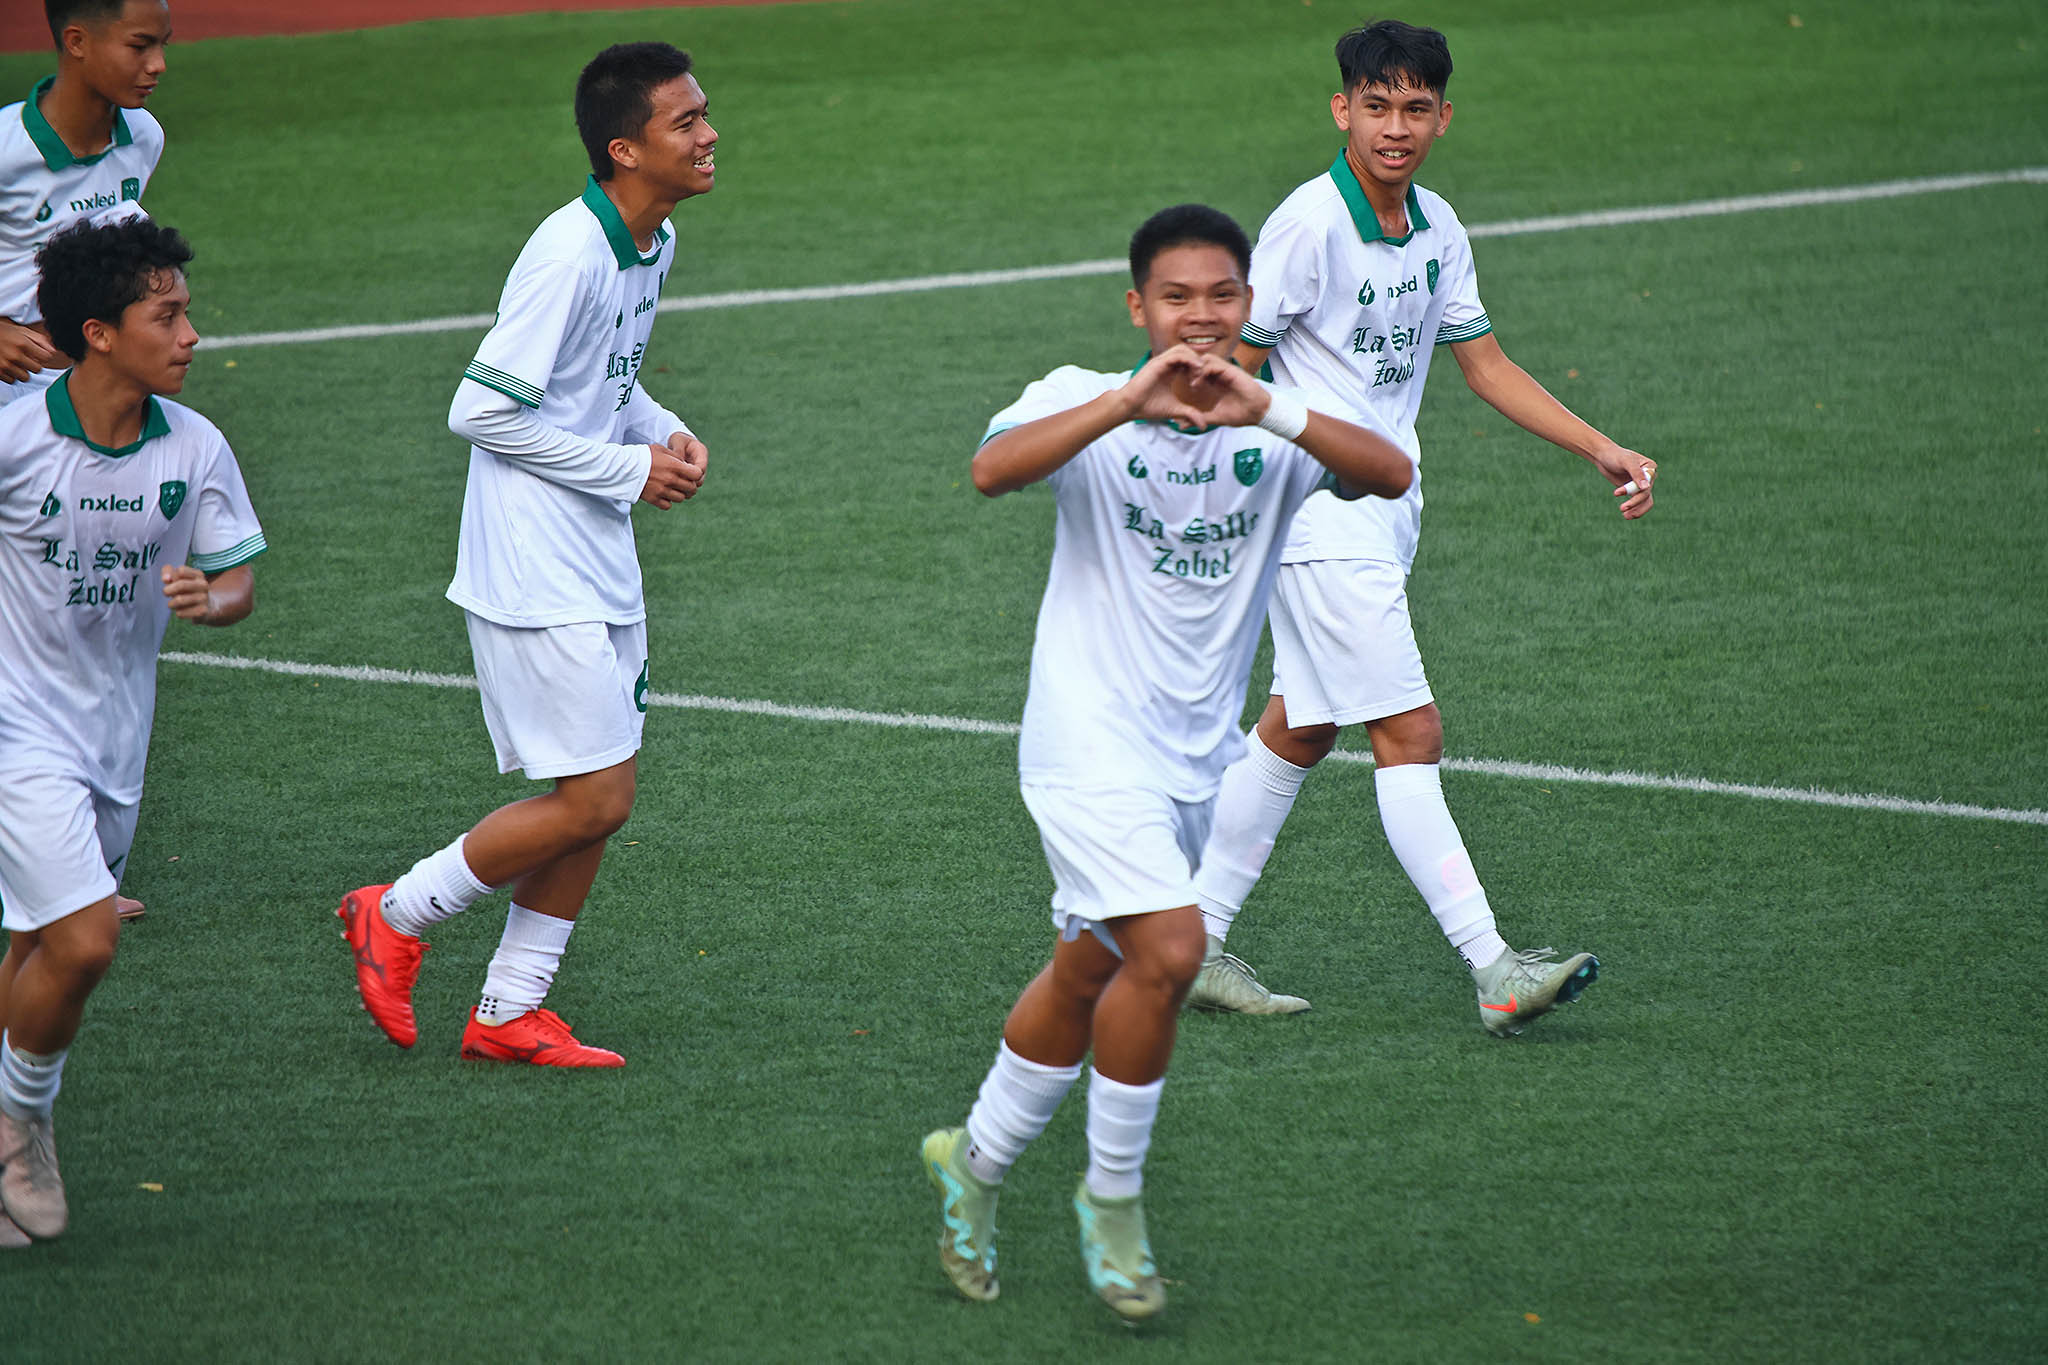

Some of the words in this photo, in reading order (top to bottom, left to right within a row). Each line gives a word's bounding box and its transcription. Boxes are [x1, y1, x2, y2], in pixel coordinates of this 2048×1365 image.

[70, 190, 117, 212] nxled
[1352, 327, 1388, 355] La
[1167, 464, 1217, 486] nxled
[79, 493, 145, 512] nxled
[1123, 502, 1165, 540] La
[39, 537, 80, 572] La
[1151, 545, 1232, 579] Zobel
[65, 574, 139, 607] Zobel
